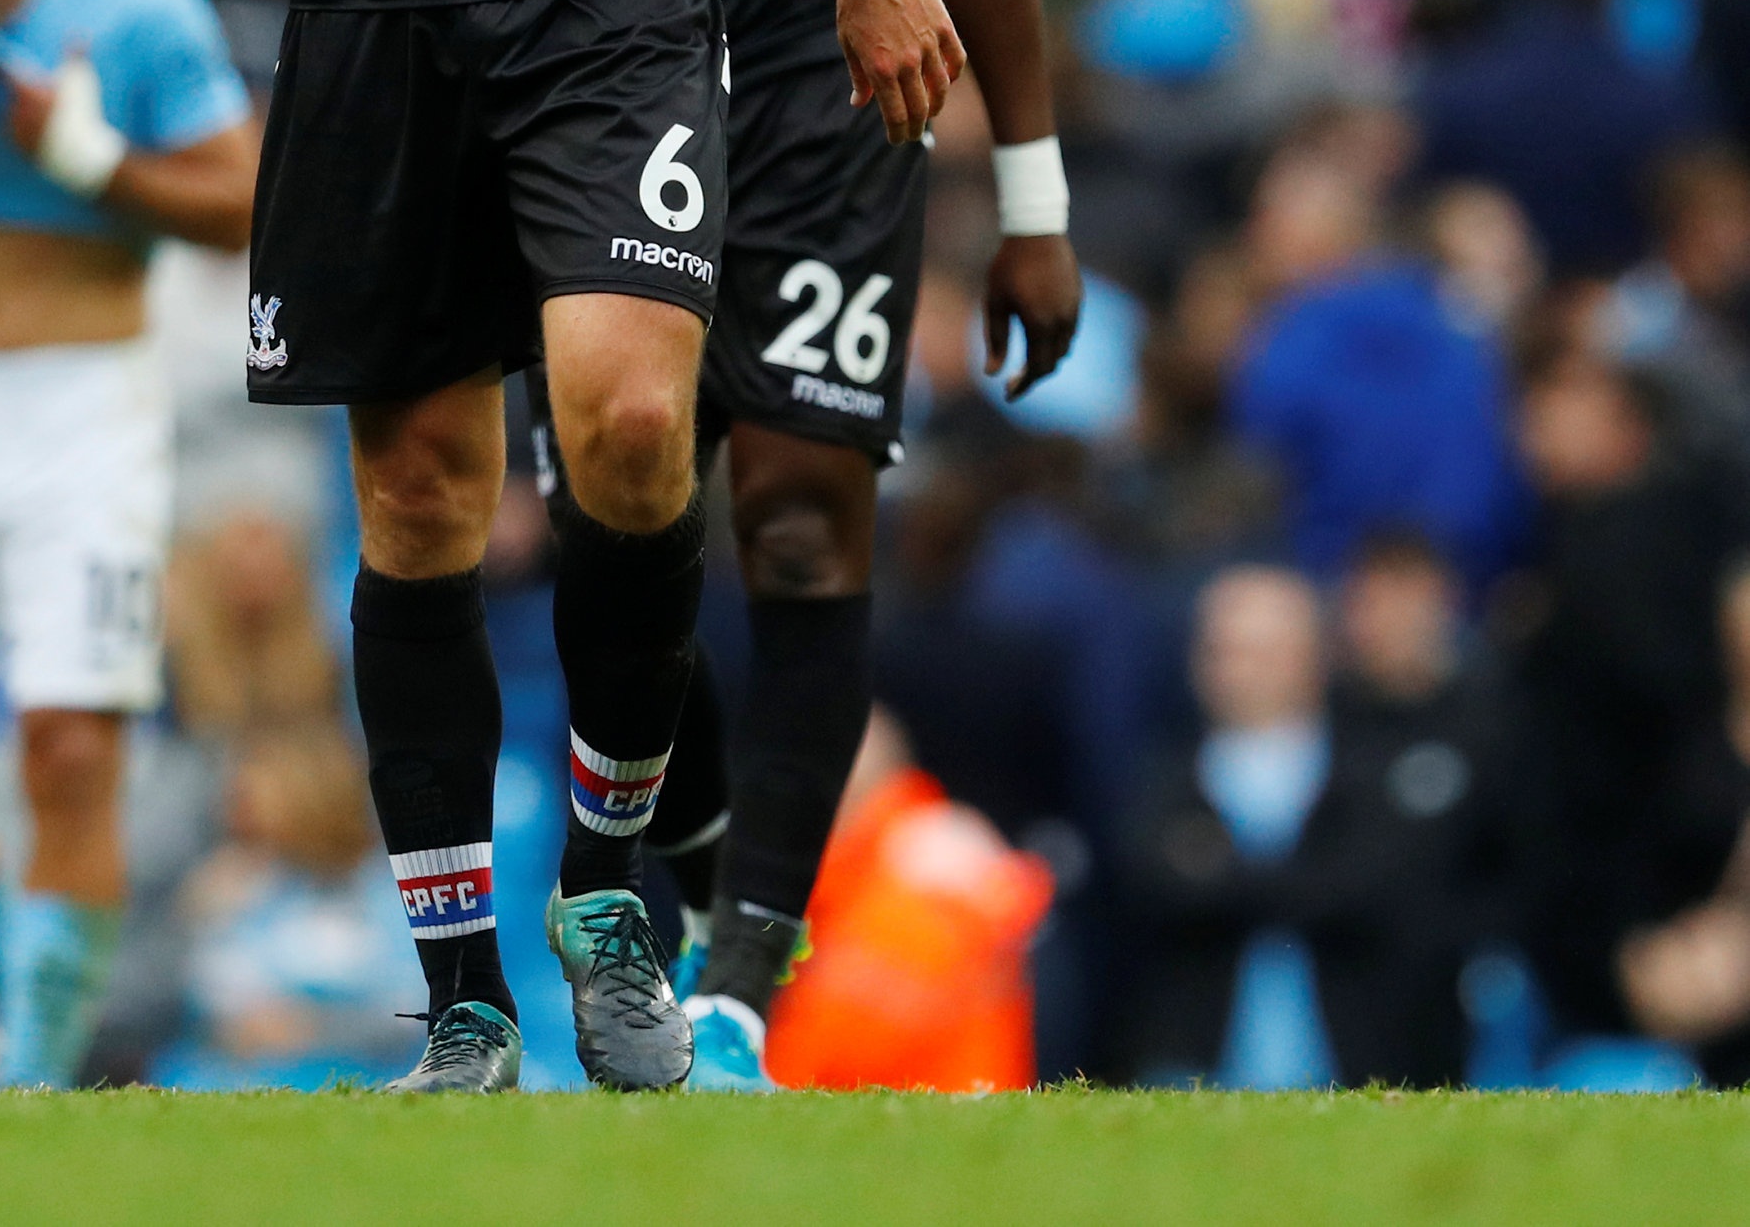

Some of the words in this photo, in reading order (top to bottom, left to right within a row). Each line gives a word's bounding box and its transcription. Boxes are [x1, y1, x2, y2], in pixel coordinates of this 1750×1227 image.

[639, 123, 705, 233] 6
[610, 237, 714, 286] macron
[760, 257, 893, 384] 26
[603, 774, 664, 812] CPF
[401, 880, 477, 918] CPFC
